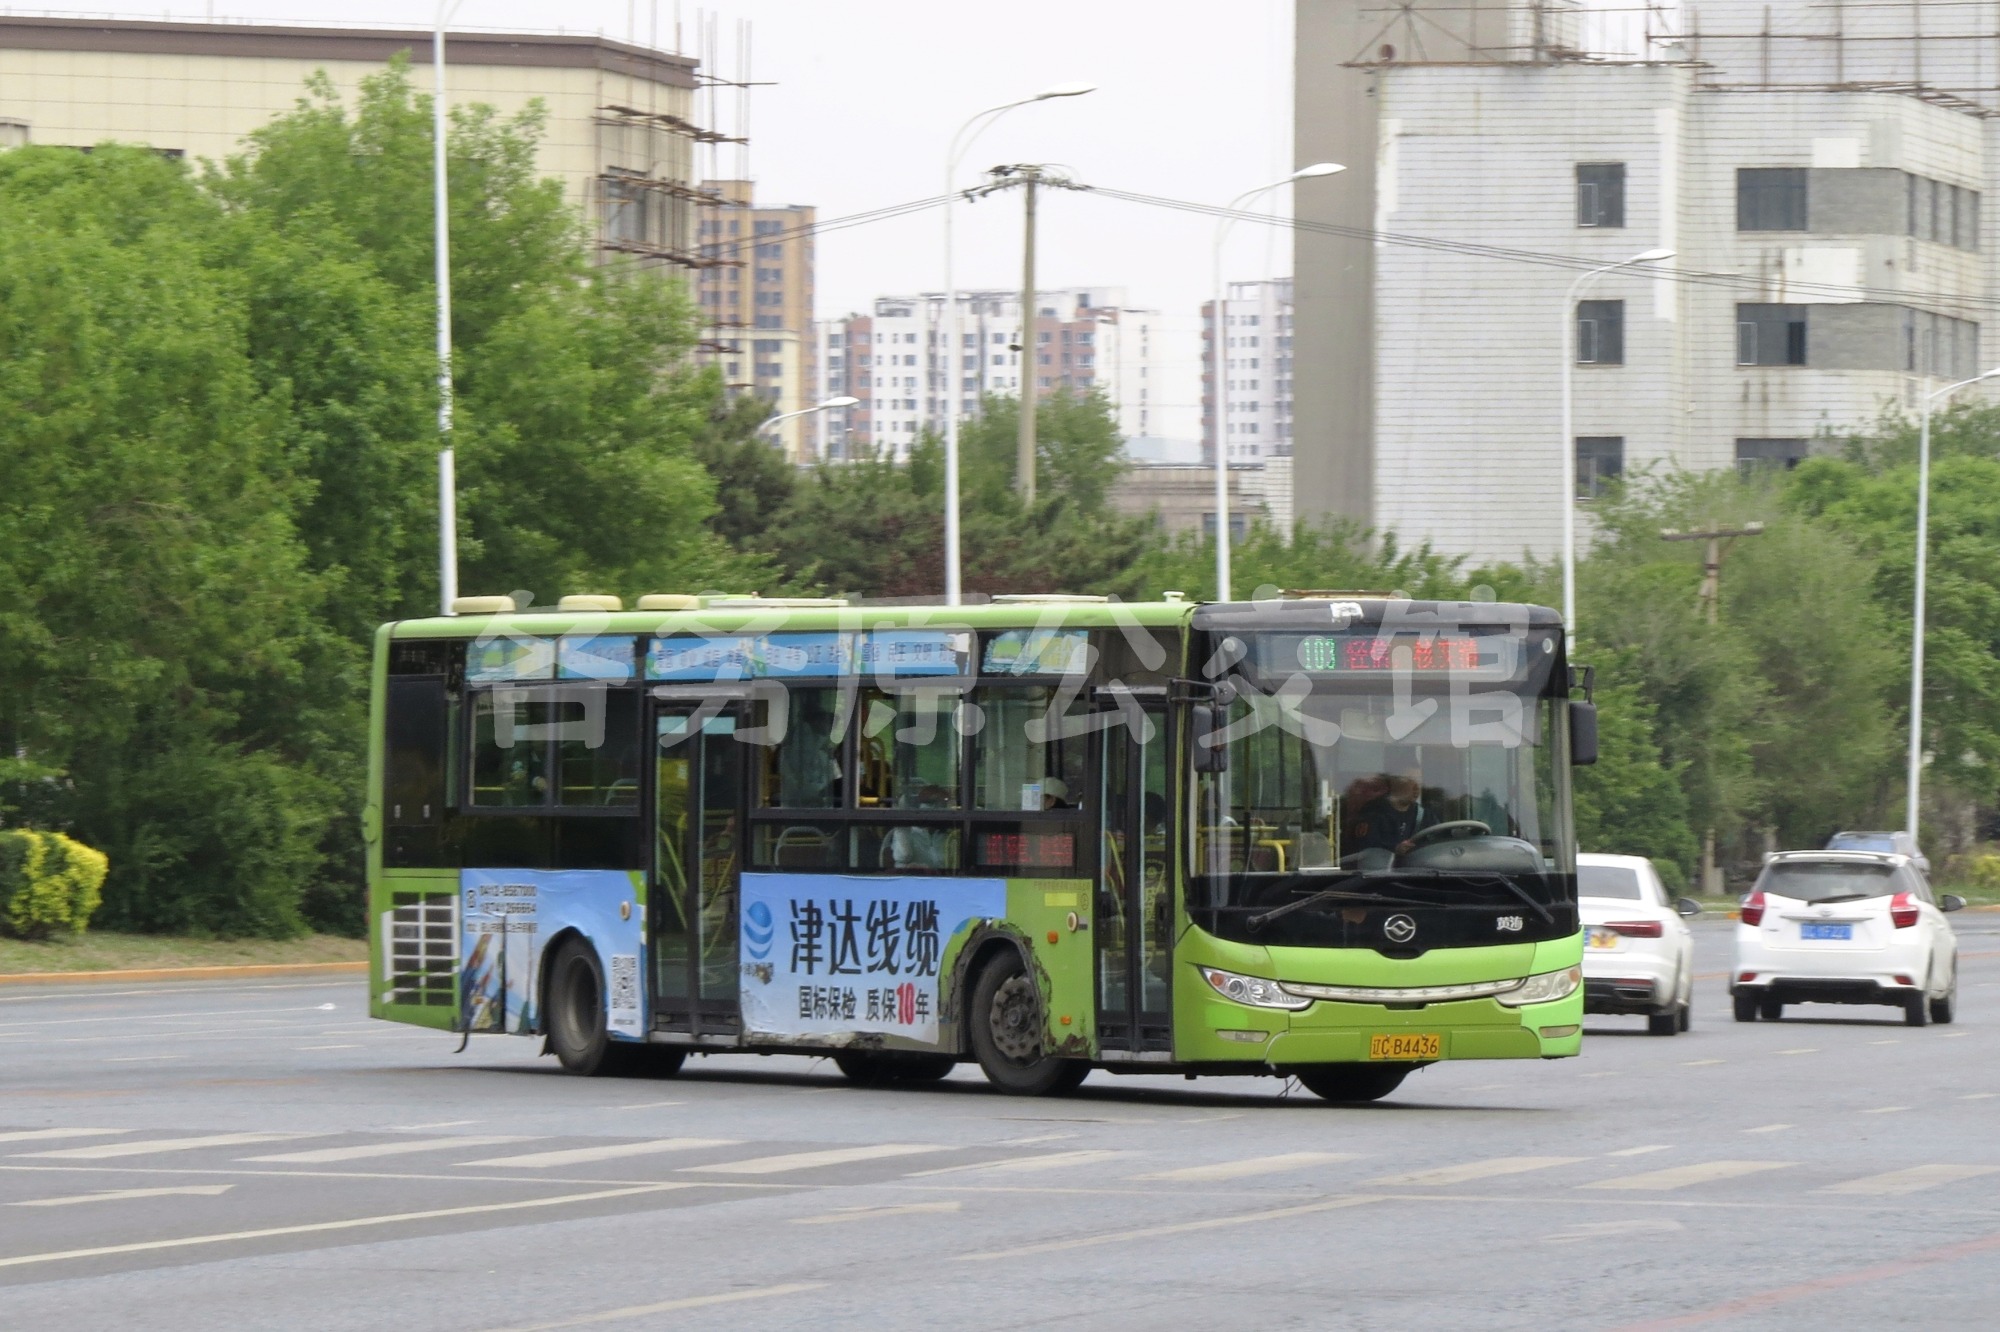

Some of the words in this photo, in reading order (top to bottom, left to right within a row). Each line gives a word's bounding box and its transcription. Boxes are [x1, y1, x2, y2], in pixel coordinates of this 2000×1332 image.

[1304, 638, 1336, 670] 103
[789, 898, 940, 977] 津达线缆
[1496, 915, 1523, 932] 黄海
[800, 985, 857, 1021] 国标保检
[865, 983, 930, 1025] 质保10年
